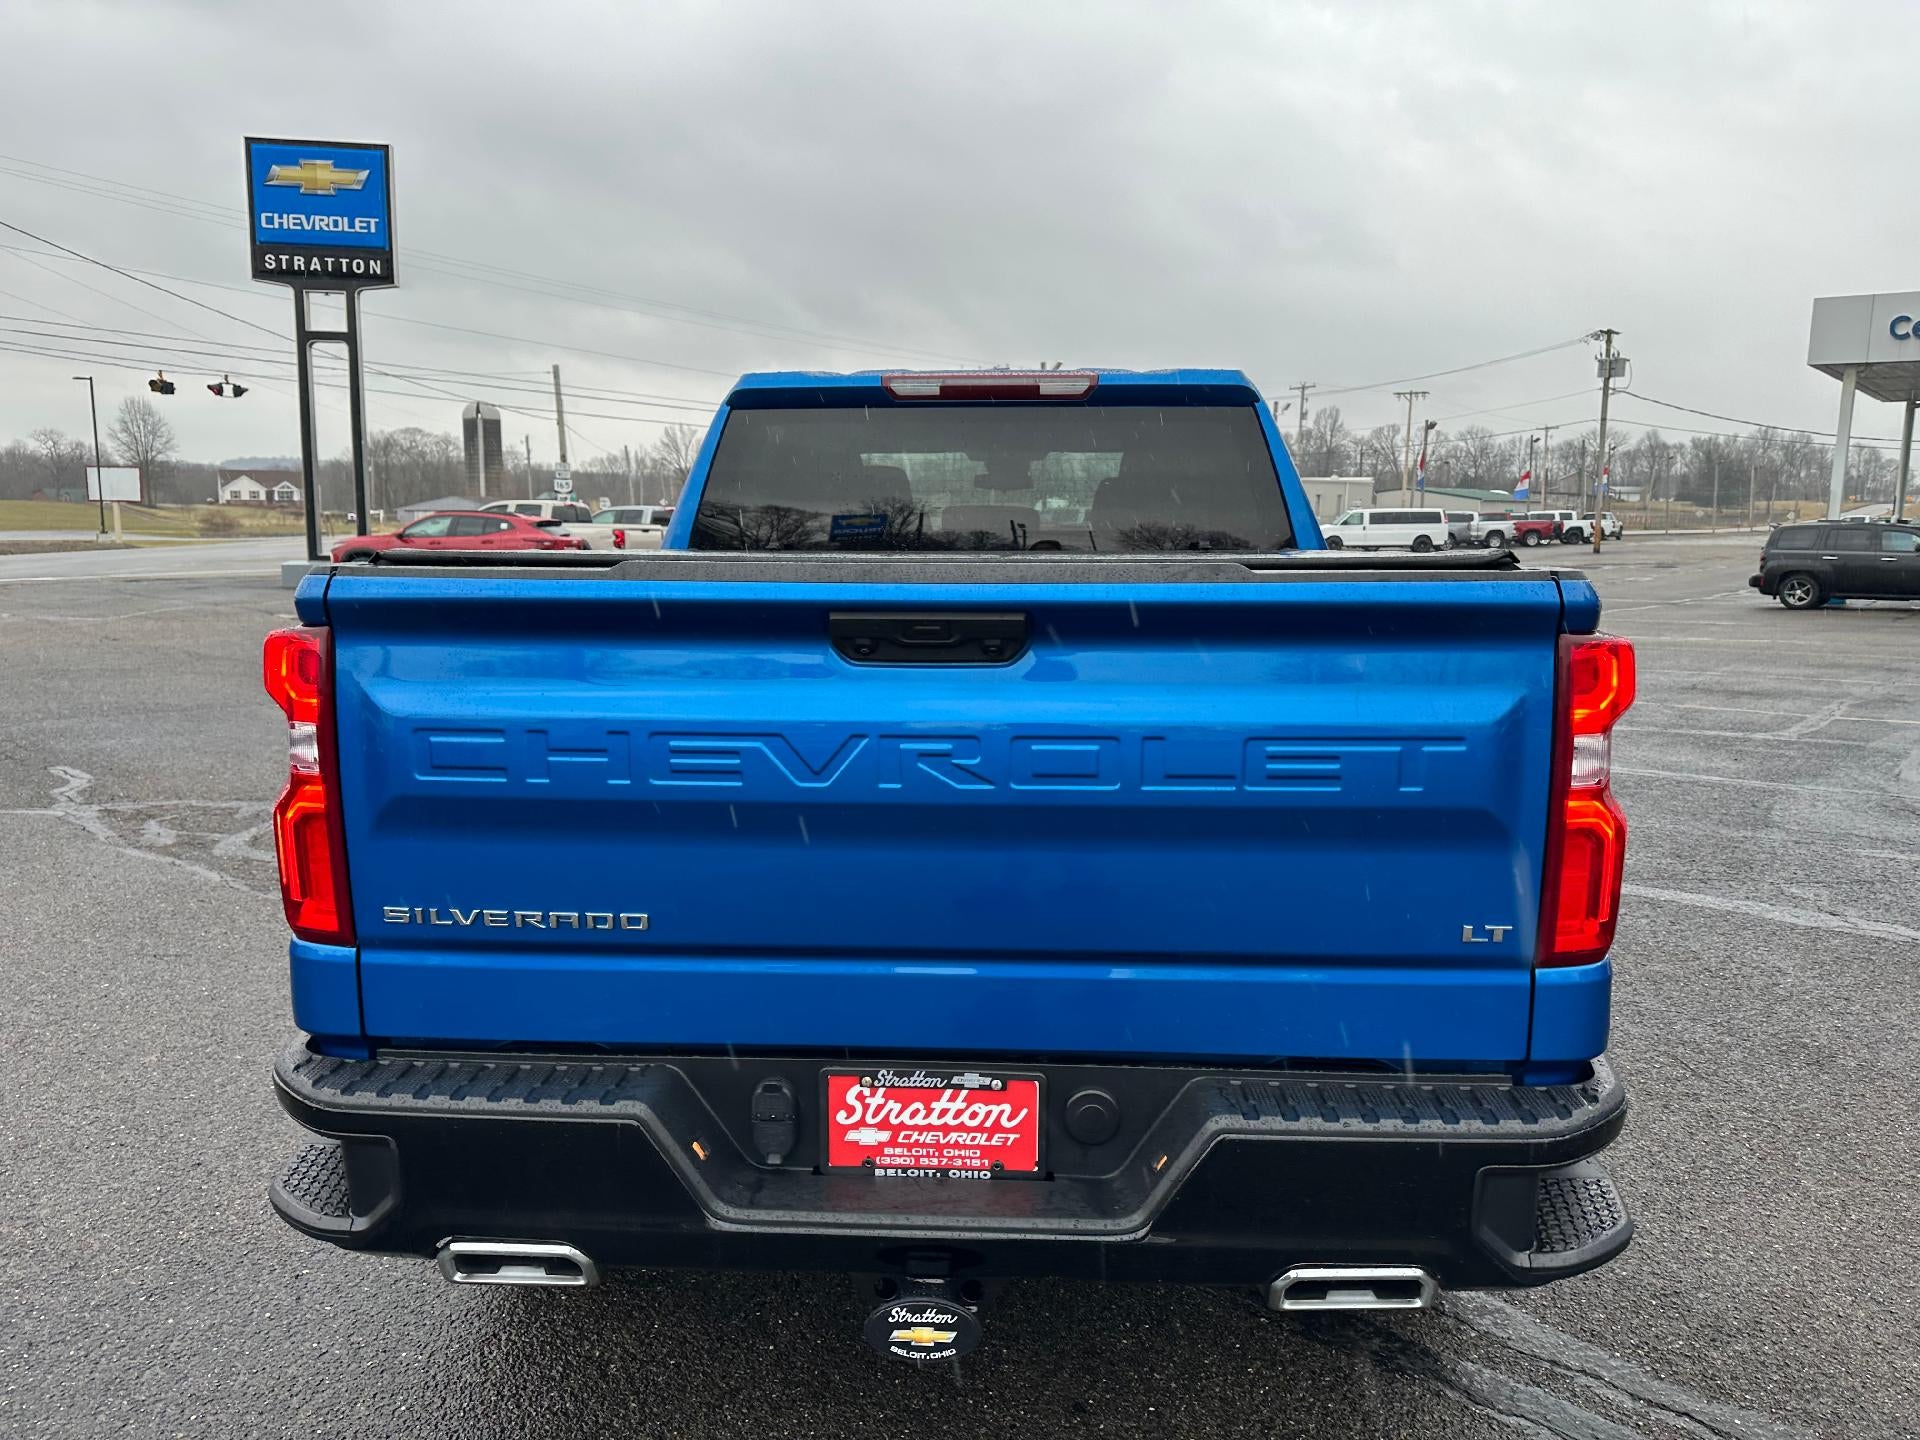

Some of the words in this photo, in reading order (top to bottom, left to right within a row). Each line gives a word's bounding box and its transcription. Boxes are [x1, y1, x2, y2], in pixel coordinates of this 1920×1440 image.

[261, 213, 379, 233] CHEVROLET
[264, 254, 381, 274] STRATTON
[413, 728, 1467, 793] CHEVROLET
[383, 906, 649, 930] SILVERADO
[1462, 924, 1513, 943] LT
[873, 1069, 948, 1088] Stratton
[835, 1084, 1029, 1129] Stratton
[897, 1130, 1021, 1146] CHEVROLET
[875, 1156, 915, 1165] (330)
[919, 1157, 990, 1167] 537-3151
[884, 1147, 939, 1157] BELOIT,
[943, 1148, 981, 1158] OHIO
[874, 1168, 941, 1178] BELOIT,
[948, 1170, 992, 1180] OHIO
[888, 1307, 958, 1324] Stratton
[930, 1348, 957, 1359] OHIO
